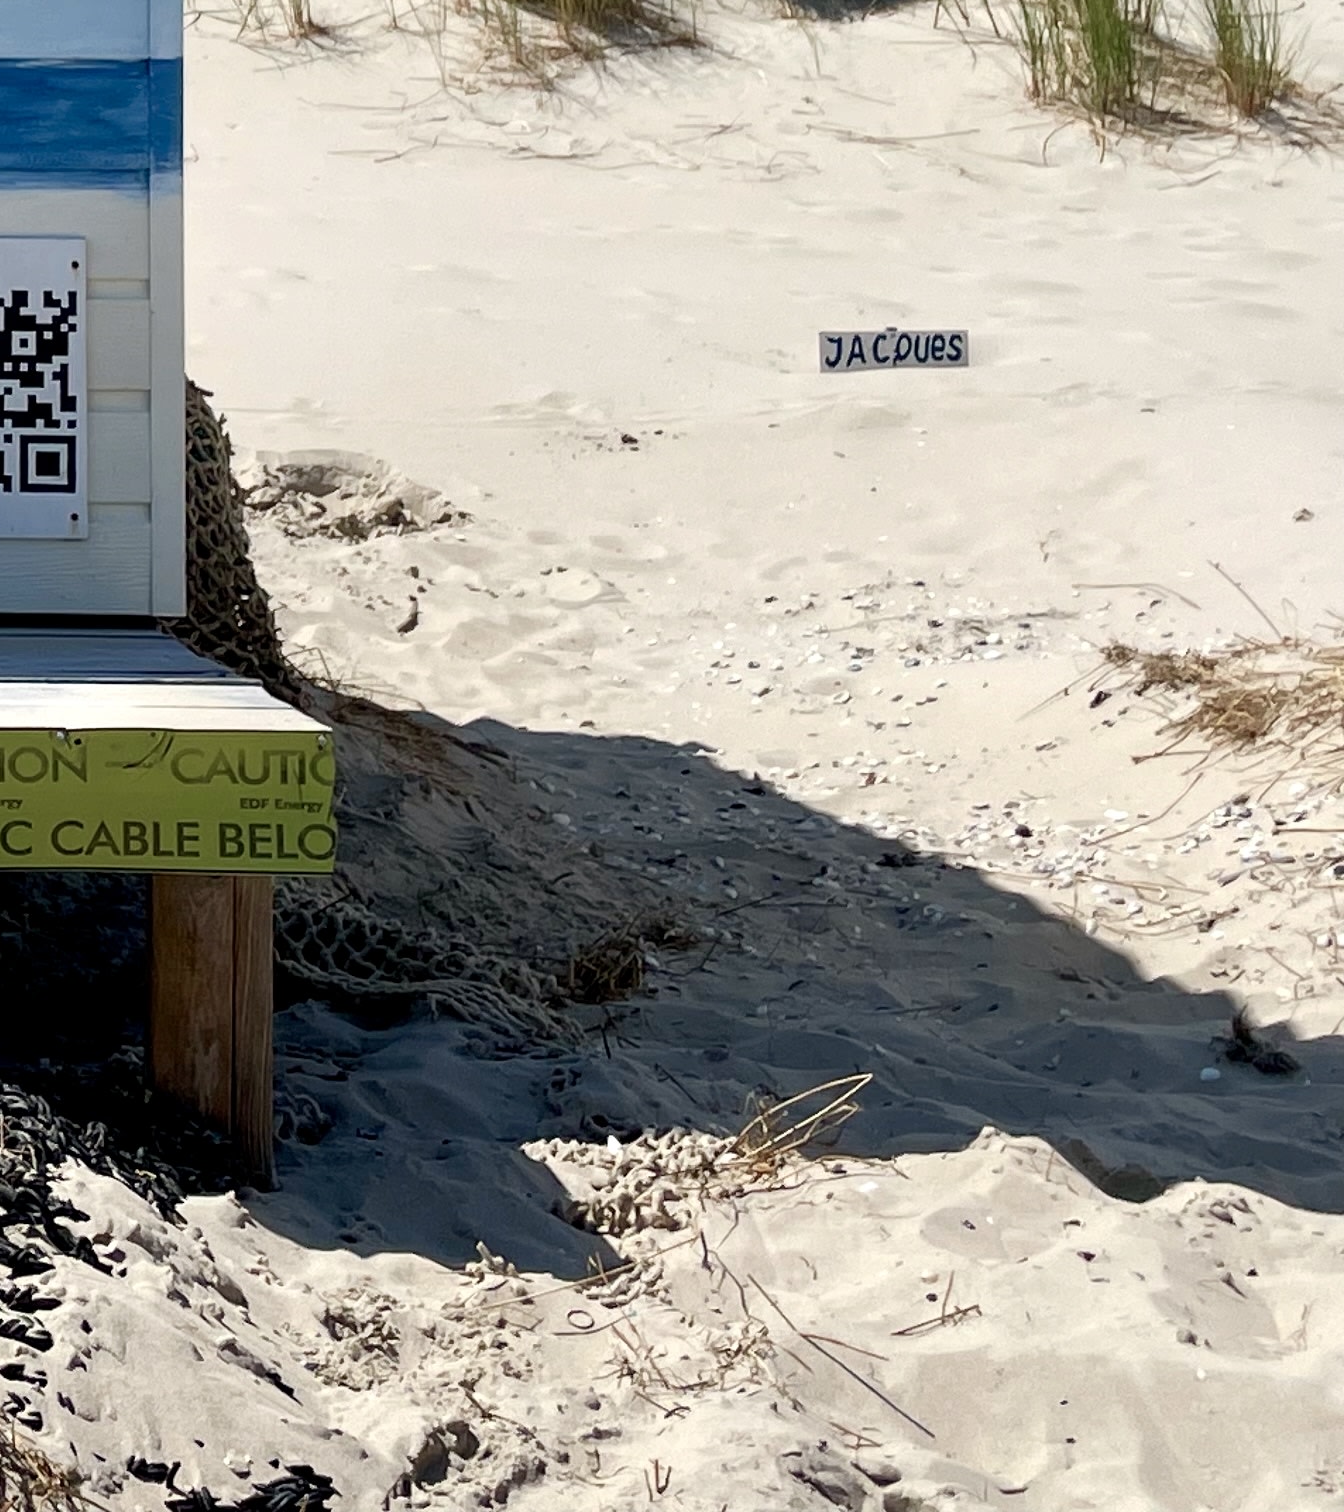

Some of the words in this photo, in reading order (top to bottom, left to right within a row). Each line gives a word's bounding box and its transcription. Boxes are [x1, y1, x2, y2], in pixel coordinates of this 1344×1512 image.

[240, 797, 269, 810] EDF
[275, 798, 323, 814] Energy
[50, 821, 200, 858] CABLE
[218, 823, 336, 860] BELO
